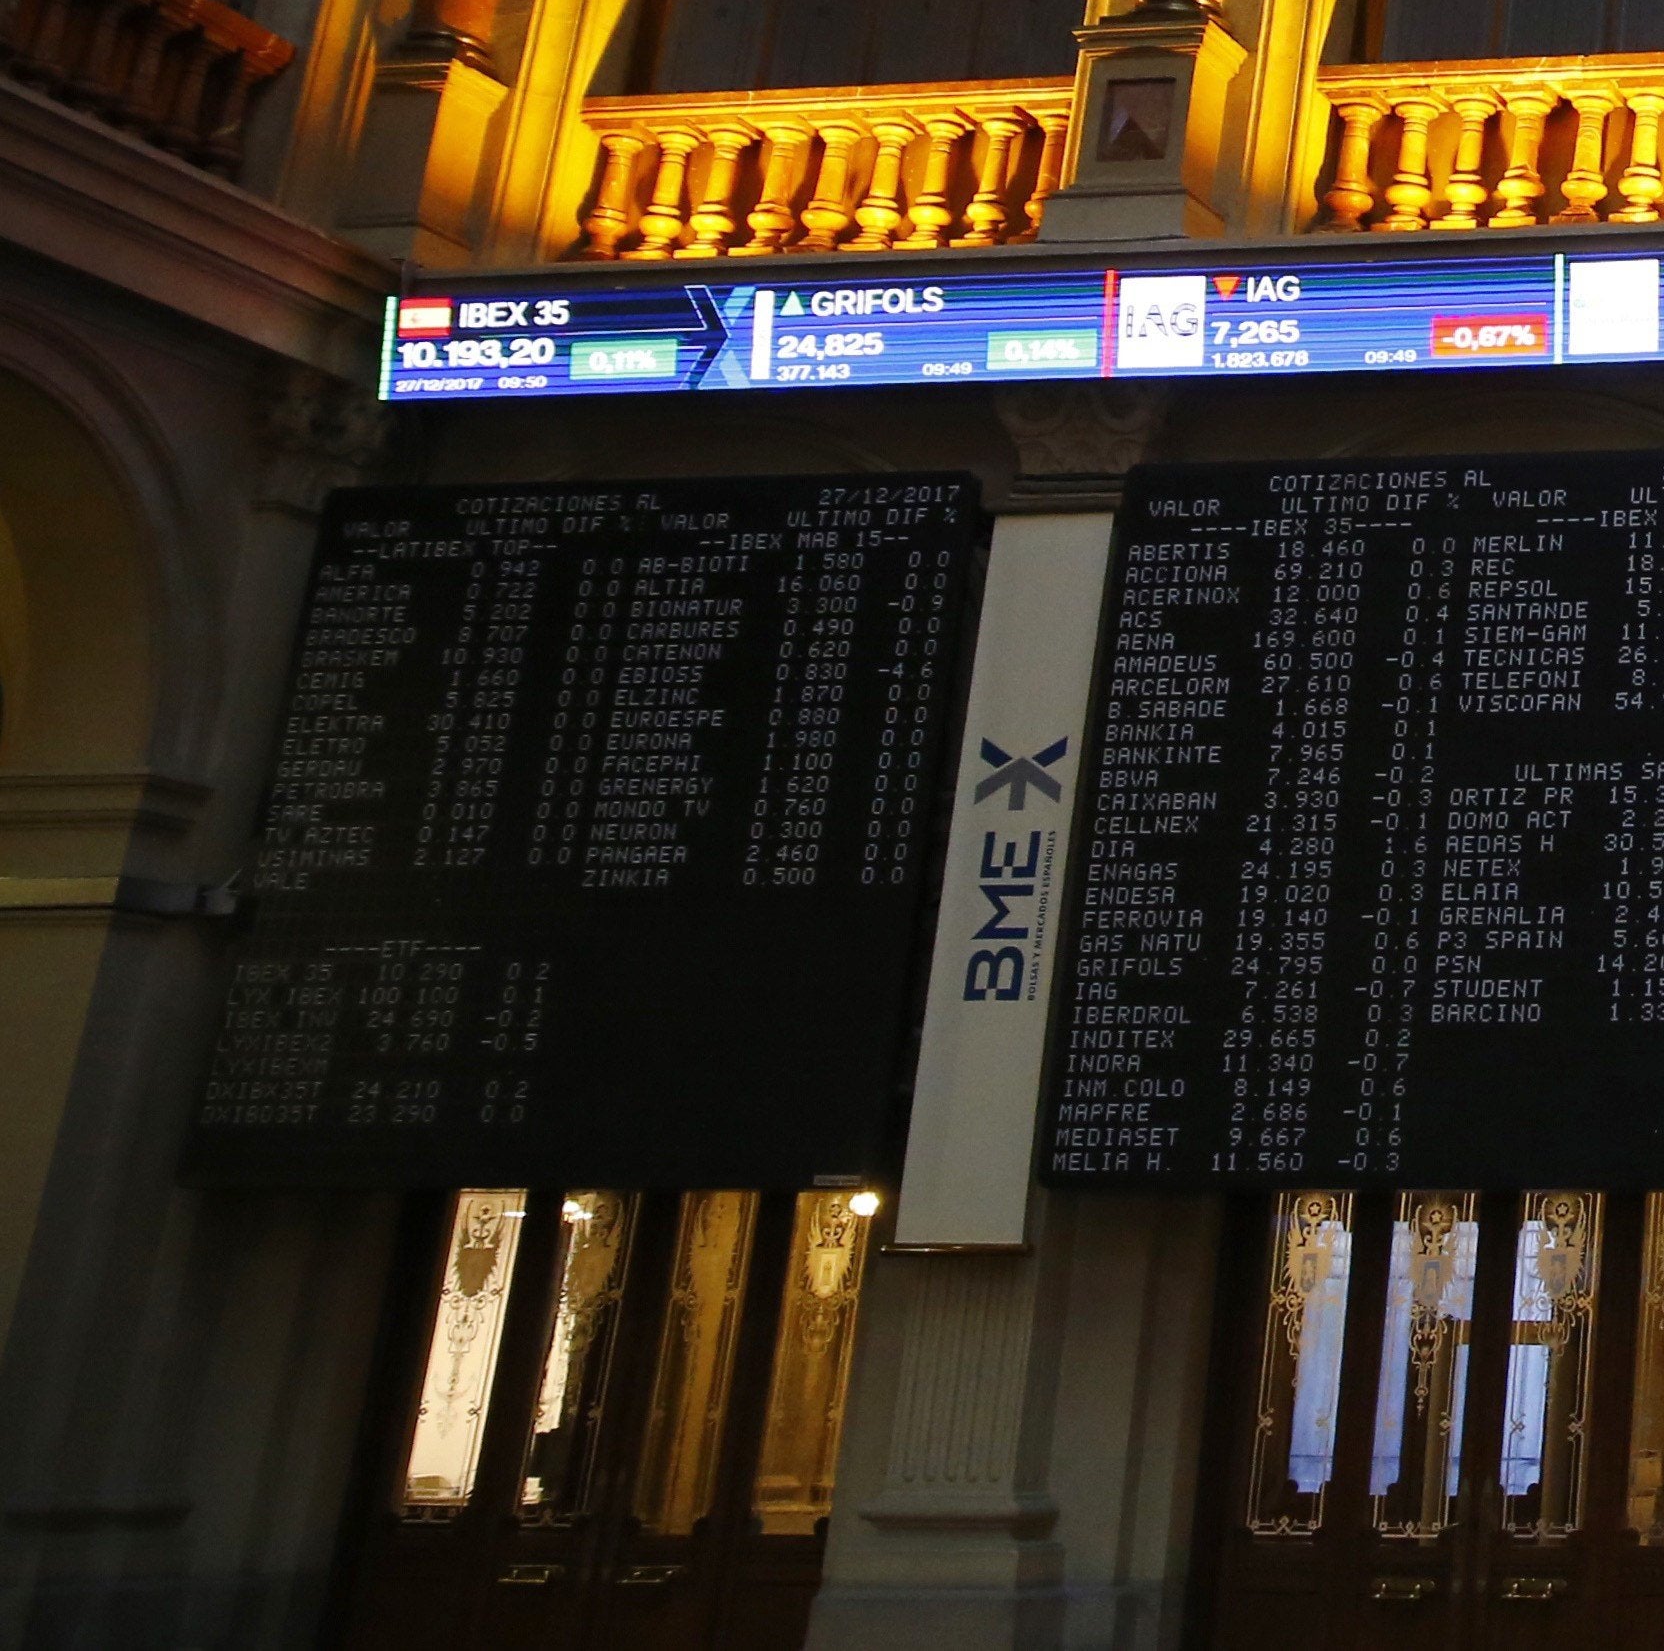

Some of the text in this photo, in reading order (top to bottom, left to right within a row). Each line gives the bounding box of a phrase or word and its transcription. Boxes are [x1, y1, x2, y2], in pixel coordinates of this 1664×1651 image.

[1245, 276, 1301, 303] IAG
[811, 286, 944, 317] GRIFOLS
[459, 299, 570, 328] IBEX 35
[1125, 303, 1199, 338] IAG
[1211, 319, 1300, 349] 7,265
[1441, 325, 1536, 349] -0,67%
[398, 337, 556, 368] 10.193,20
[777, 332, 884, 360] 24,825
[1364, 349, 1417, 364] 09:49
[498, 375, 548, 389] 09:50
[776, 363, 850, 381] 377.143
[1269, 471, 1447, 493] COTIZACIONES
[1464, 469, 1491, 488] AL
[819, 485, 960, 505] 27/12/2017
[1129, 539, 1365, 562] ABERTIS 18.460
[1469, 580, 1558, 599] REPSOL
[626, 621, 740, 639] CARBURES
[618, 665, 704, 685] EBIOSS
[1459, 694, 1582, 712] VISCOFAN
[610, 709, 725, 728] EUROESPE
[602, 754, 701, 773] FACEPHI
[1515, 762, 1624, 783] ULTIMAS
[582, 868, 669, 888] ZINKIA
[963, 830, 1042, 1001] BME
[1433, 979, 1544, 999] STUDENT
[1056, 1127, 1180, 1148] MEDIASET
